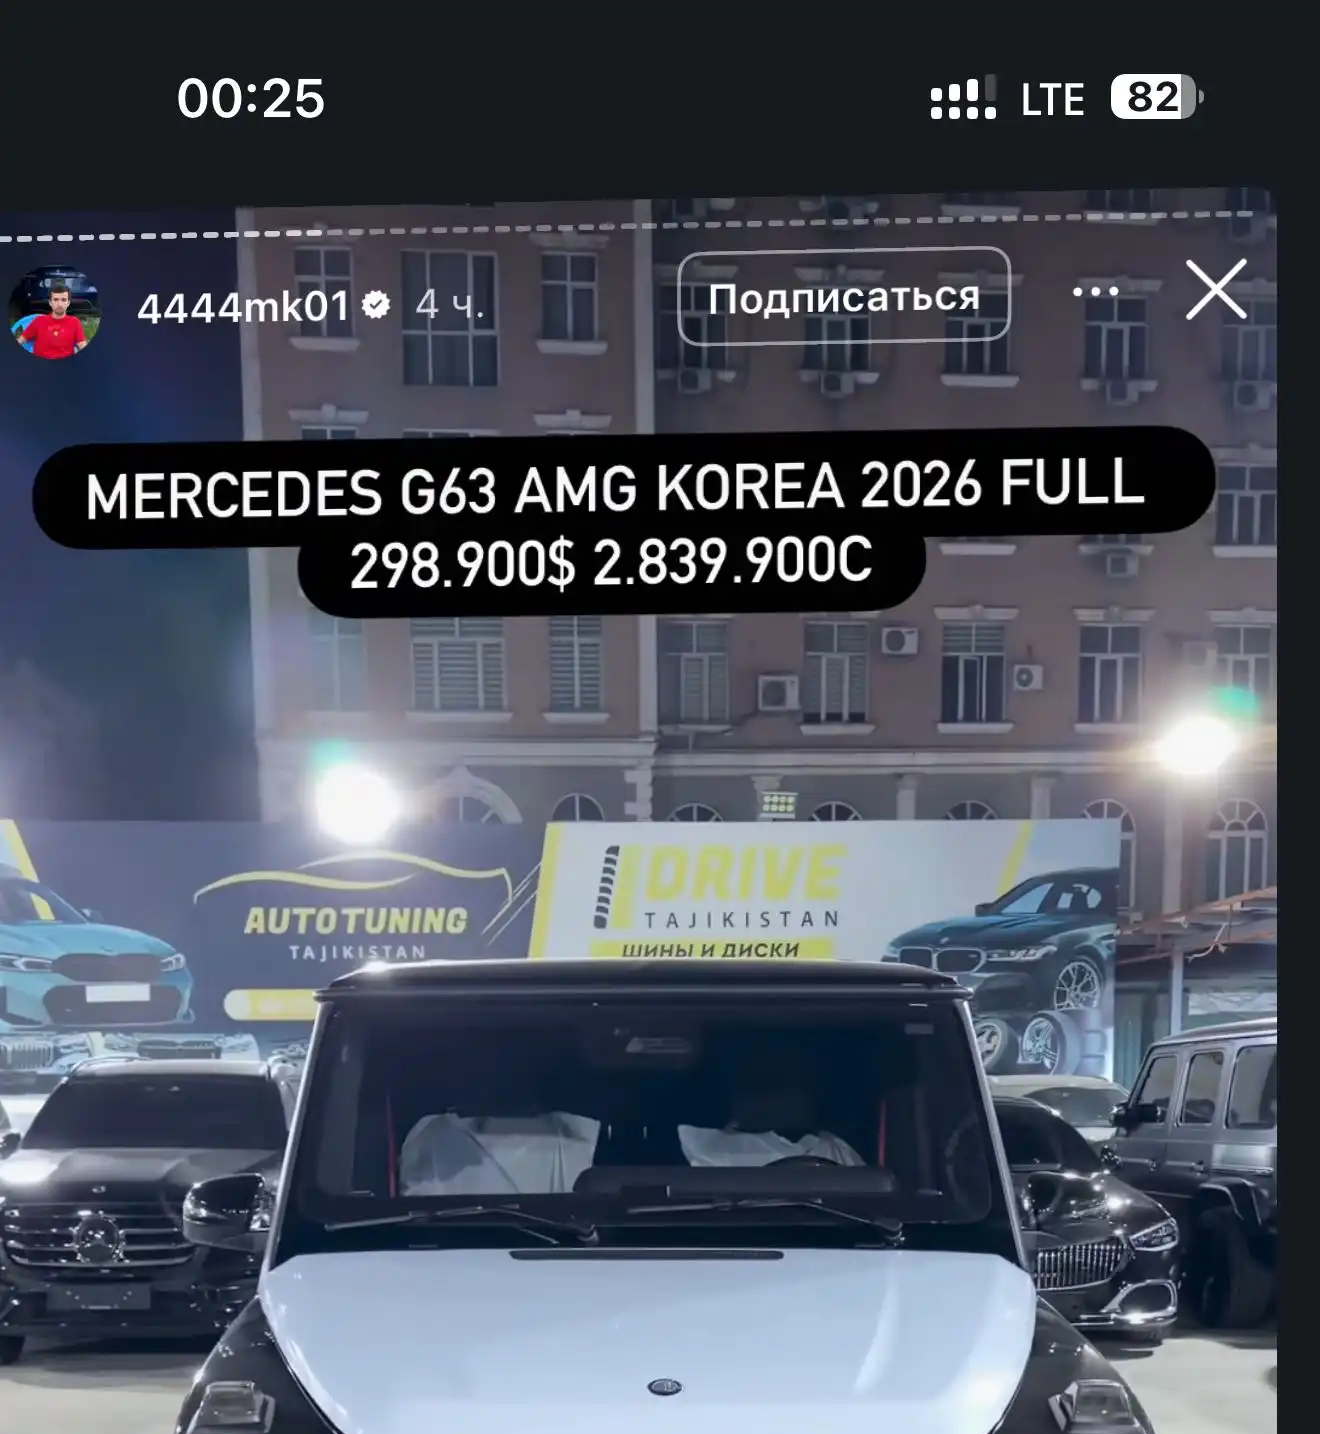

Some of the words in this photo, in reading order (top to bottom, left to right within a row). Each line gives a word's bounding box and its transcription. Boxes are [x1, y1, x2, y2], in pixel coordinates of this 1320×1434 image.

[645, 911, 838, 929] TAJIKISTAN
[289, 945, 426, 962] TAJIKISTAN
[622, 943, 694, 958] ШИНЫ
[701, 943, 716, 958] И
[721, 942, 800, 958] ДИСКИ
